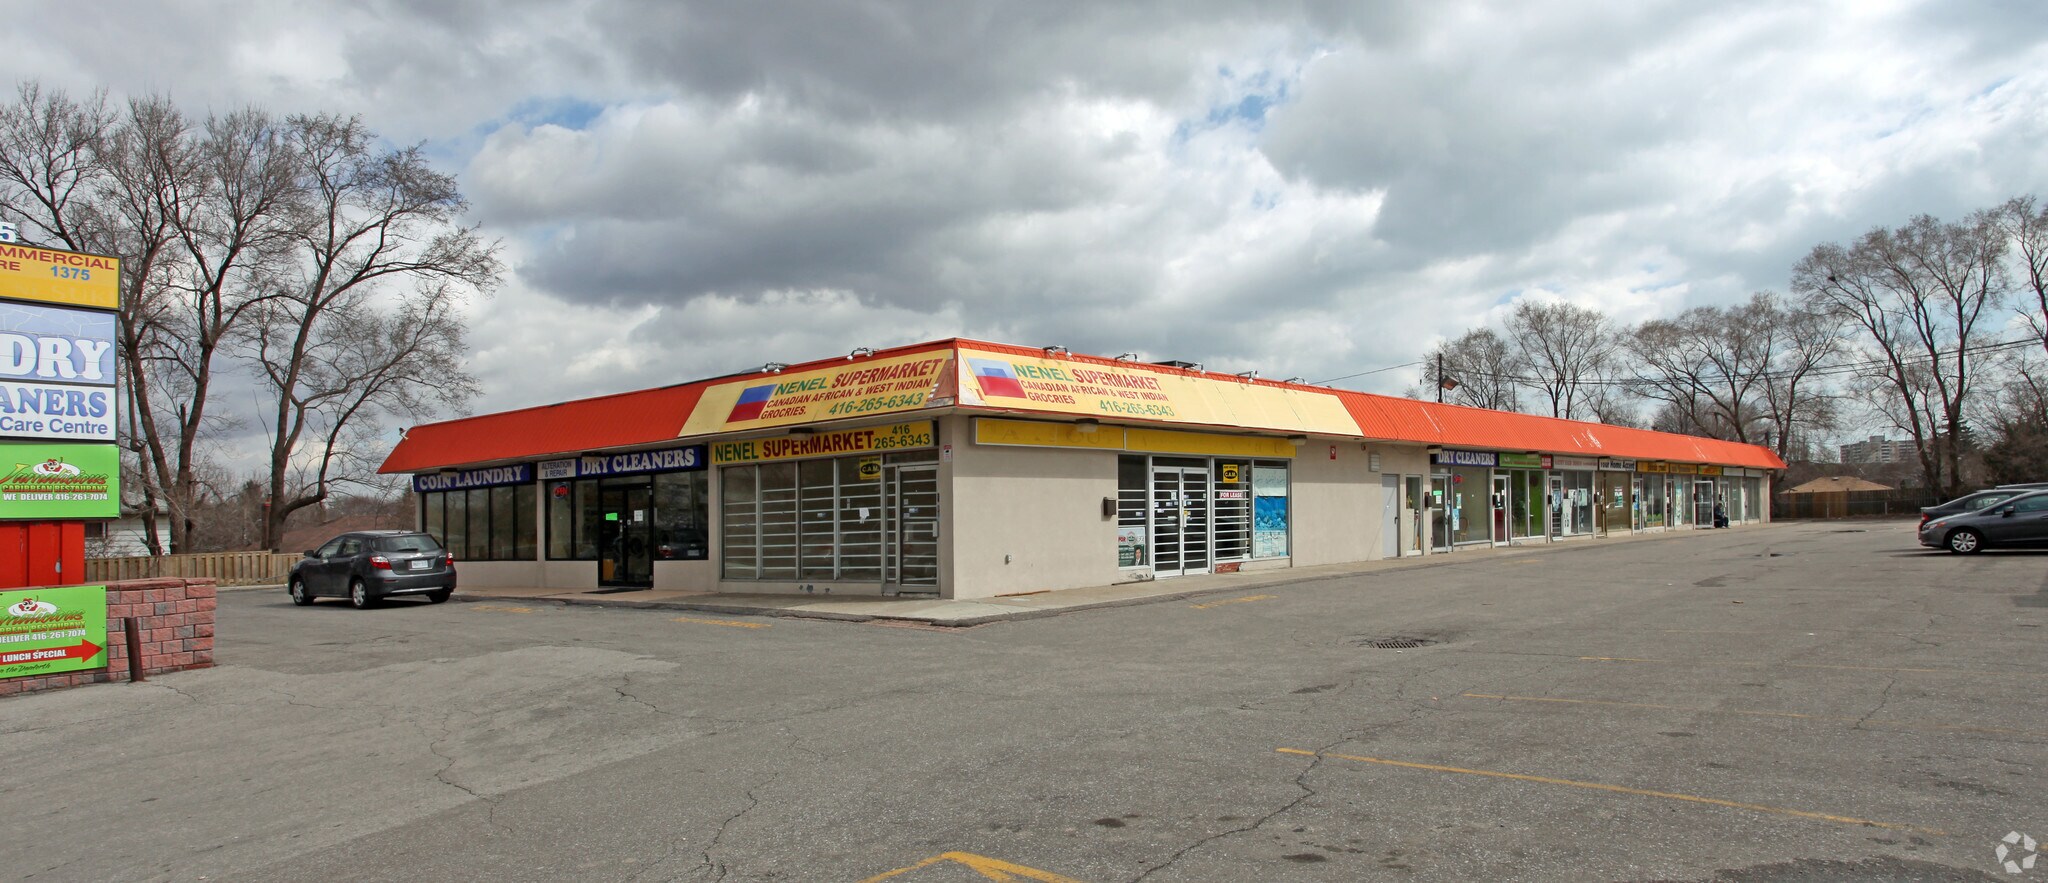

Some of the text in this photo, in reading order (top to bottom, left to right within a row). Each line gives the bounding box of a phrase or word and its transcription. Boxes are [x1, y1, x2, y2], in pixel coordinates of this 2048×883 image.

[0, 245, 115, 271] MMERCIAL
[0, 259, 21, 271] RE
[50, 265, 91, 281] 1375
[0, 333, 111, 380] DRY
[774, 358, 943, 396] NENEL SUPERMARKET
[1012, 364, 1162, 392] NENEL SUPERMARKET
[766, 377, 932, 408] CANADIAN AFRICAN & WEST INDIAN
[1020, 380, 1170, 402] CANADIAN AFRICAN & WEST INDIAN
[1027, 391, 1076, 405] GROCRIES
[0, 386, 107, 418] ANERS
[828, 392, 924, 415] 416-265-6343
[1099, 399, 1175, 417] 416-265-6343
[0, 417, 108, 435] Care Centre
[891, 424, 910, 435] 416
[715, 430, 874, 462] NENEL SUPERMARKET
[874, 433, 931, 449] 265-6343
[541, 460, 572, 470] ALTERATION
[581, 448, 695, 475] DRY CLEANERS
[1438, 450, 1455, 463] DRY
[1455, 451, 1495, 466] CLEANERS
[419, 465, 523, 490] COIN LAUNDRY
[544, 467, 567, 478] & REPAIR
[2, 484, 108, 493] CARIBBEAN RESTAURANT
[3, 492, 108, 501] WE DELIVER 416-261-7074
[32, 629, 86, 640] 416-261-7074
[2, 649, 67, 663] LUNCH SPECIAL
